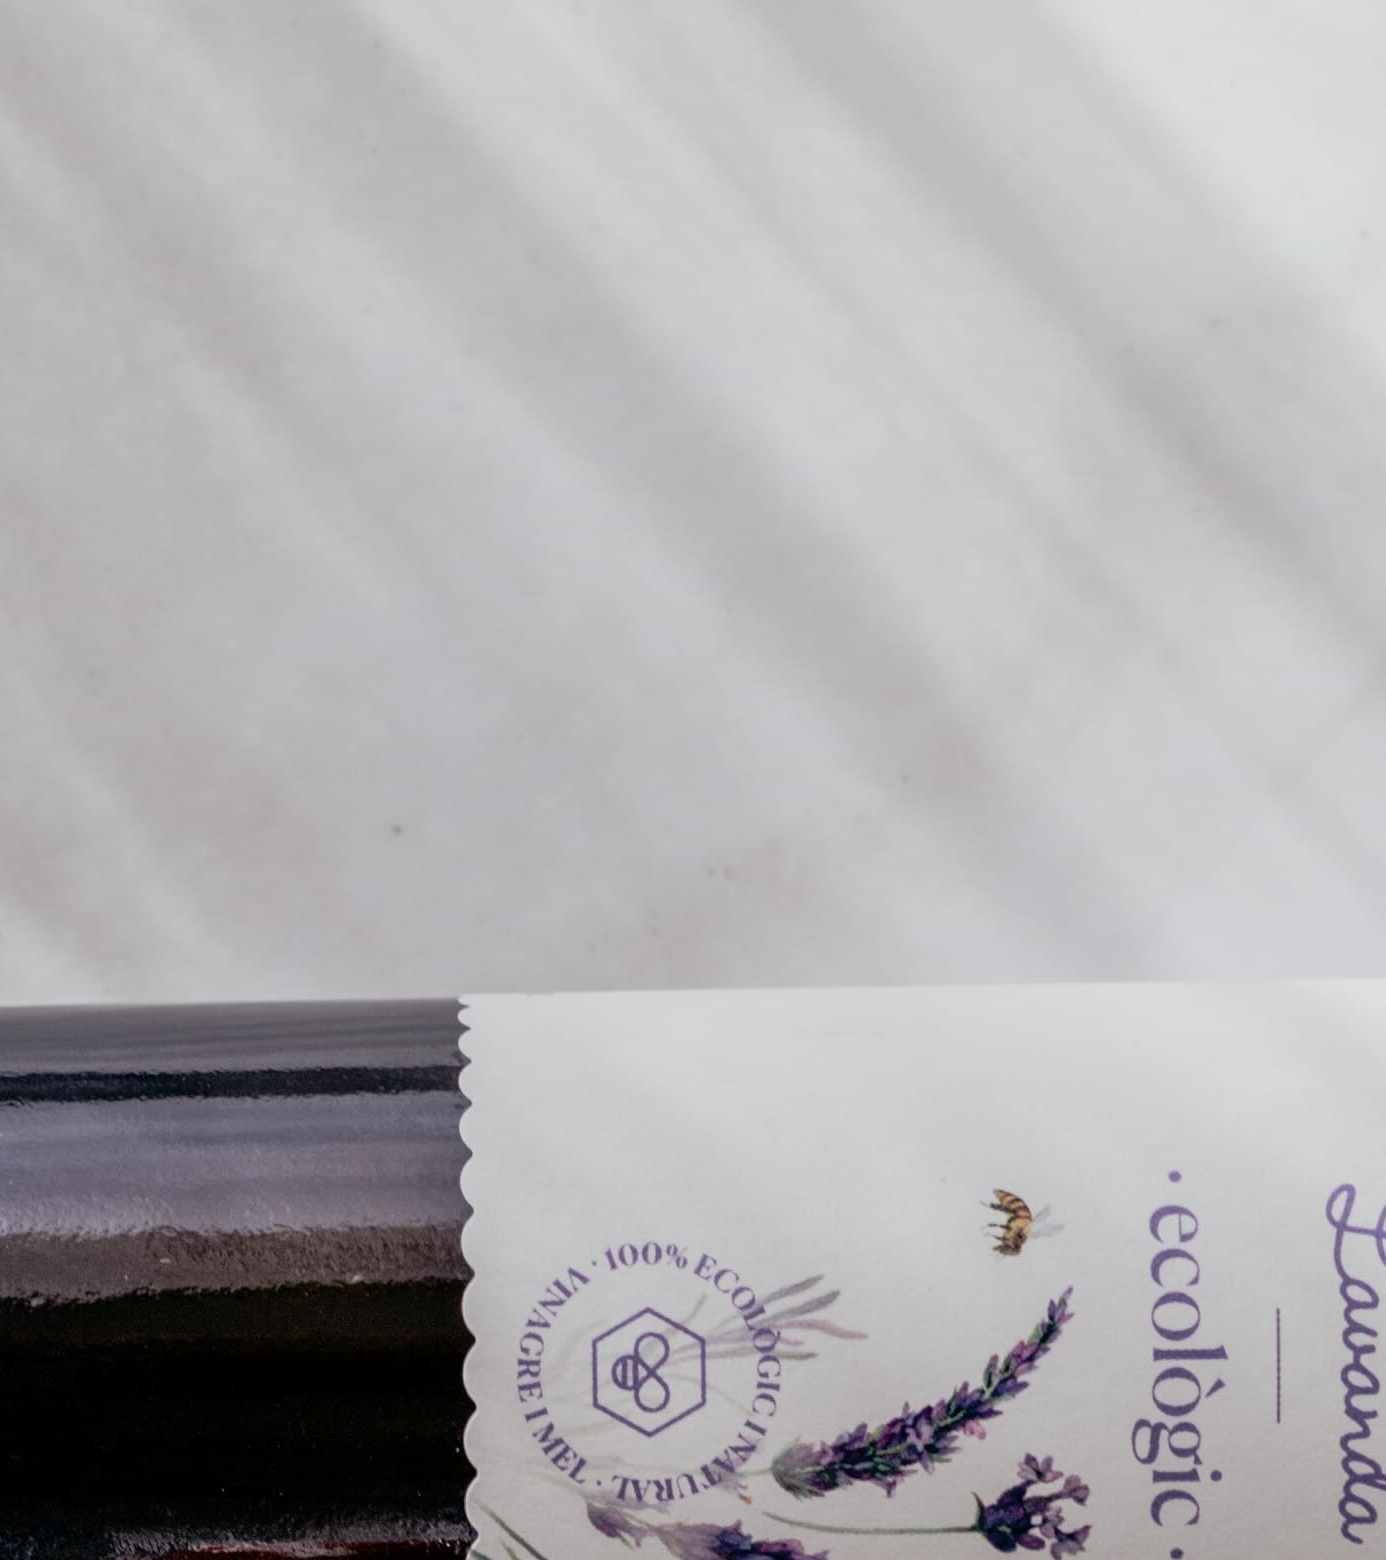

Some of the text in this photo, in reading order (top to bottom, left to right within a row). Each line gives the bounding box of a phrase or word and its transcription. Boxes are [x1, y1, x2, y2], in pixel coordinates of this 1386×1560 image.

[516, 1266, 591, 1486] VINAGRE I MEL
[604, 1240, 782, 1504] 100% ECOLÒGIC I NATURAL
